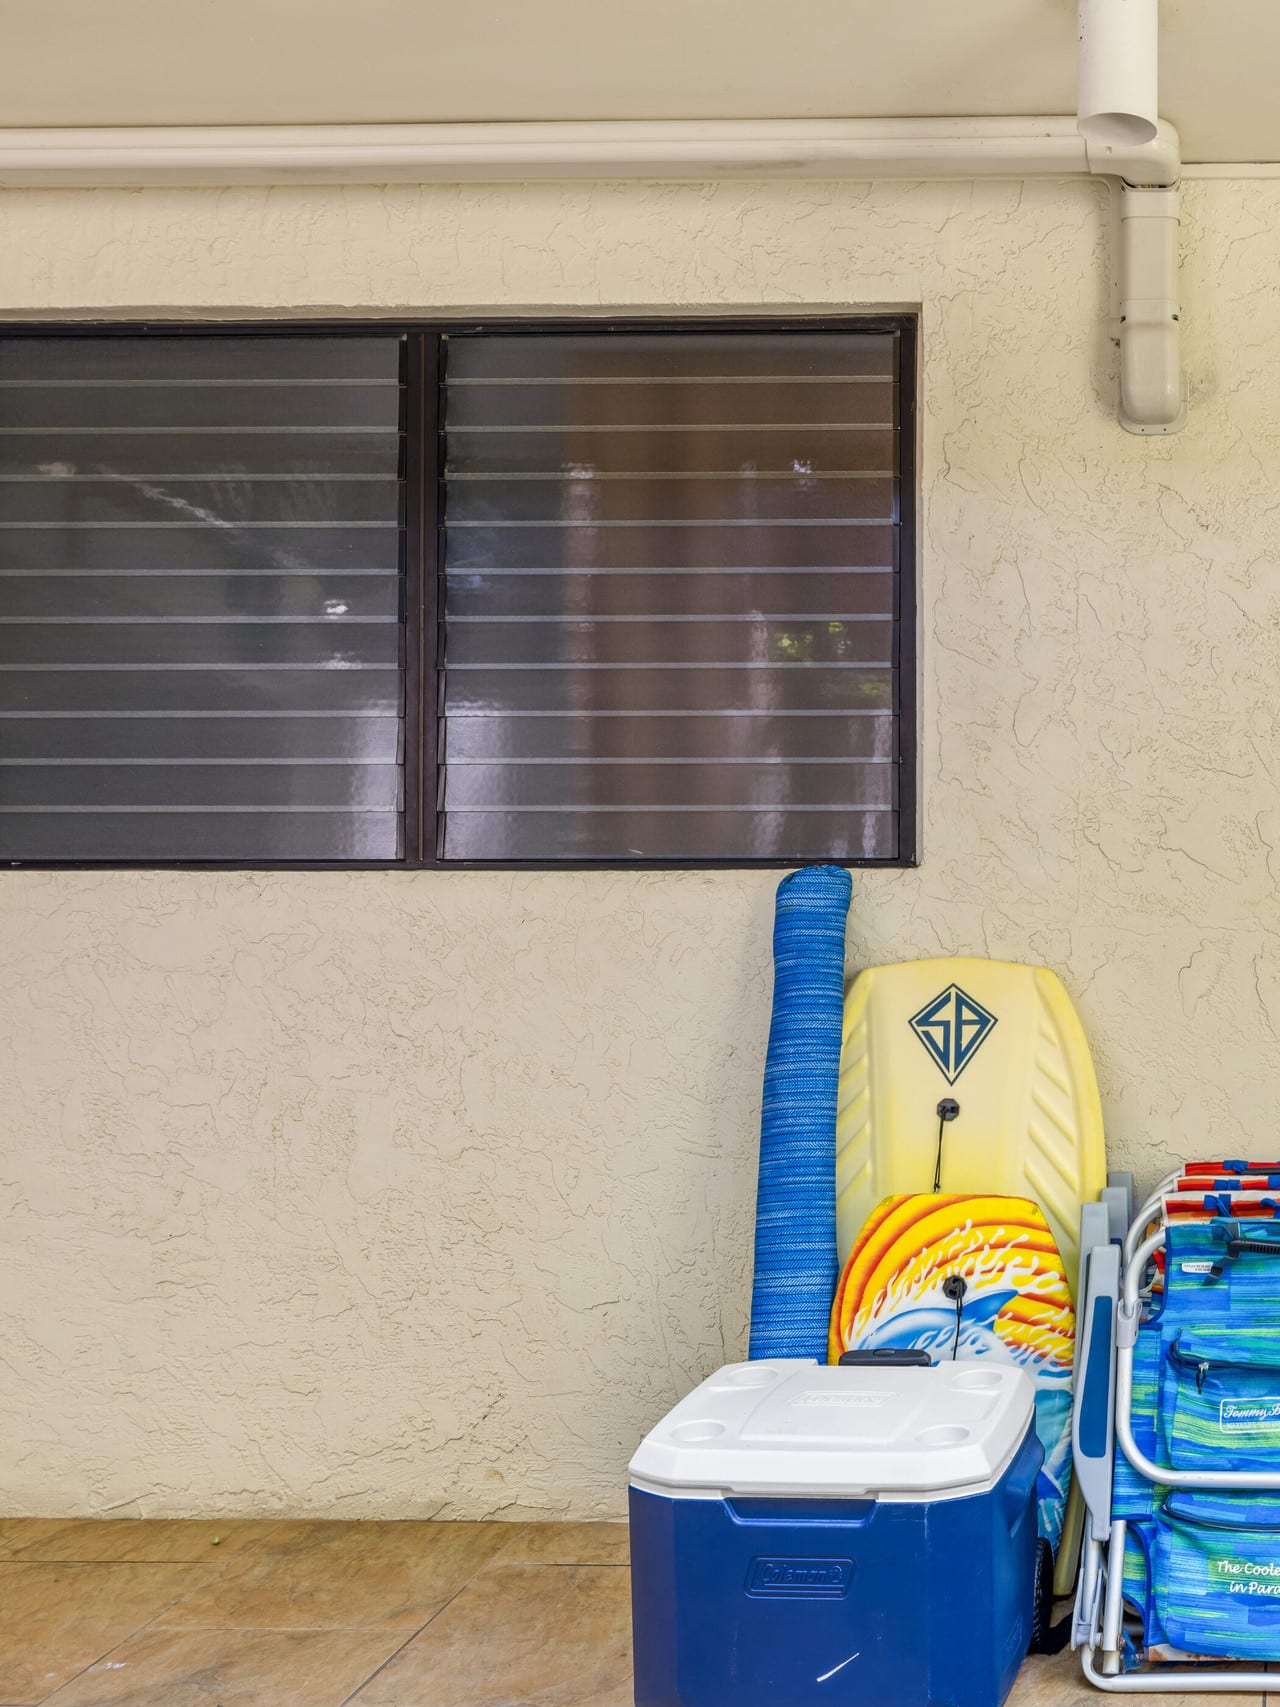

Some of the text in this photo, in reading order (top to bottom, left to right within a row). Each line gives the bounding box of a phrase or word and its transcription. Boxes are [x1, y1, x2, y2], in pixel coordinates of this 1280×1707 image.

[1223, 1405, 1268, 1421] Tommy
[1217, 1560, 1243, 1574] The
[1229, 1581, 1248, 1593] in
